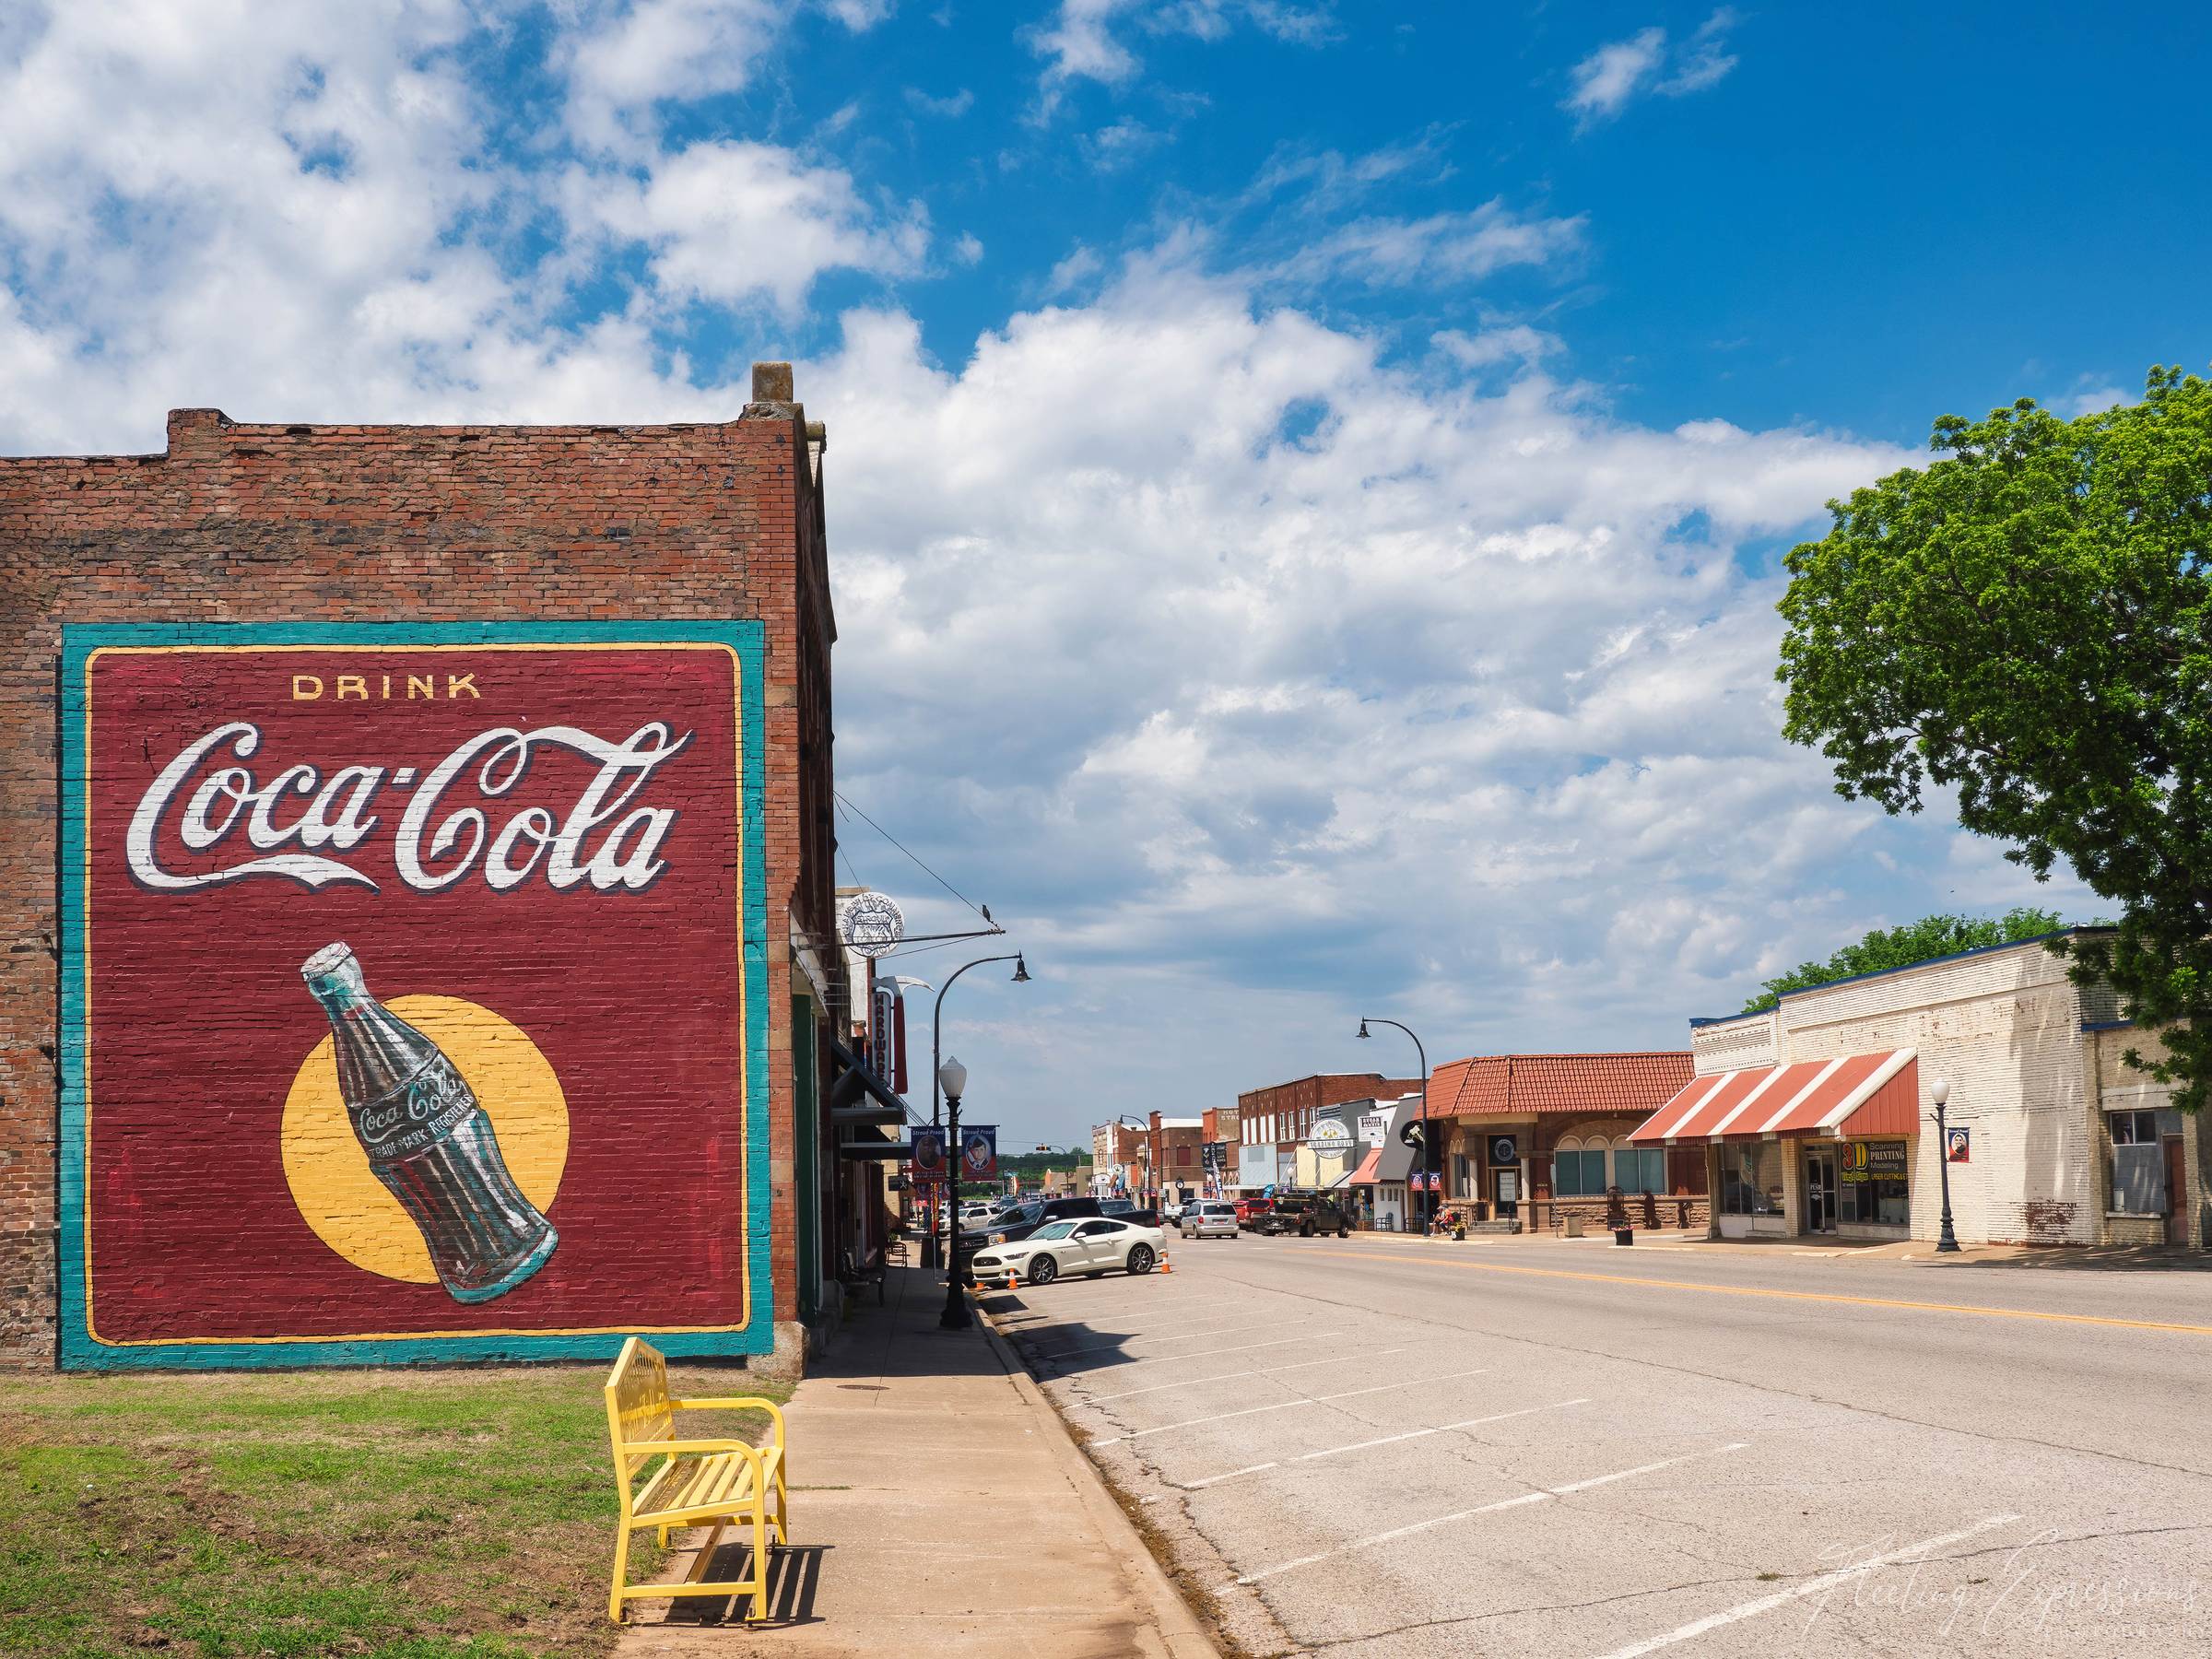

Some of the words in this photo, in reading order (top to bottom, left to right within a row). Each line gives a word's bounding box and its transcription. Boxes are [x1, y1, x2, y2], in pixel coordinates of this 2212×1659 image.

[291, 673, 483, 700] DRINK
[126, 722, 694, 892] Coca-Cola
[360, 1107, 406, 1143] Coca
[407, 1064, 469, 1121] Cola
[427, 1093, 475, 1135] REGISTERED
[1843, 1143, 1869, 1171] 3D
[1870, 1143, 1904, 1151] Scanning
[1870, 1150, 1905, 1160] PRINTING
